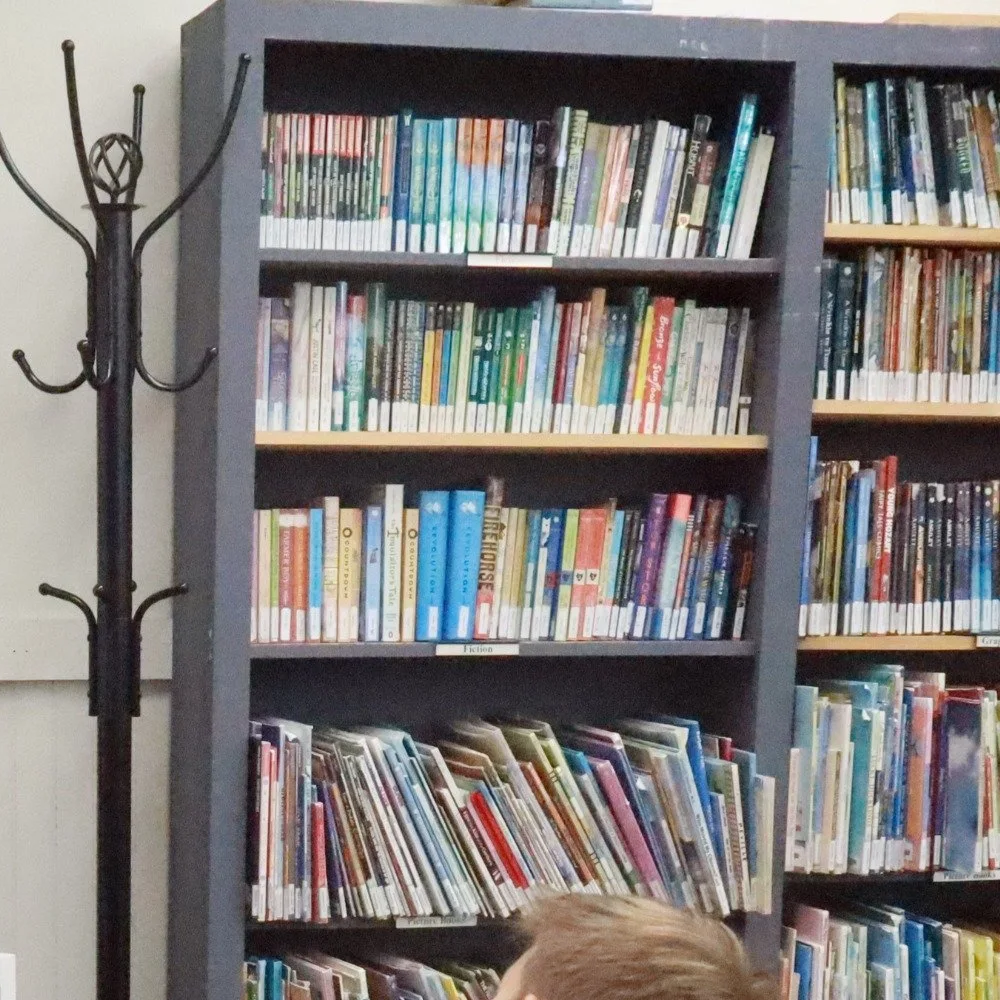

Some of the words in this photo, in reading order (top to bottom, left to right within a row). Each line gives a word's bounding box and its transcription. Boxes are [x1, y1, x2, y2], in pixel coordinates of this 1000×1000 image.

[656, 315, 669, 349] Bronze
[648, 363, 662, 402] Sunflow
[886, 487, 895, 517] YOUNG
[478, 504, 501, 591] FIREHORSE
[883, 518, 894, 553] MOZART
[463, 645, 493, 653] Fiction
